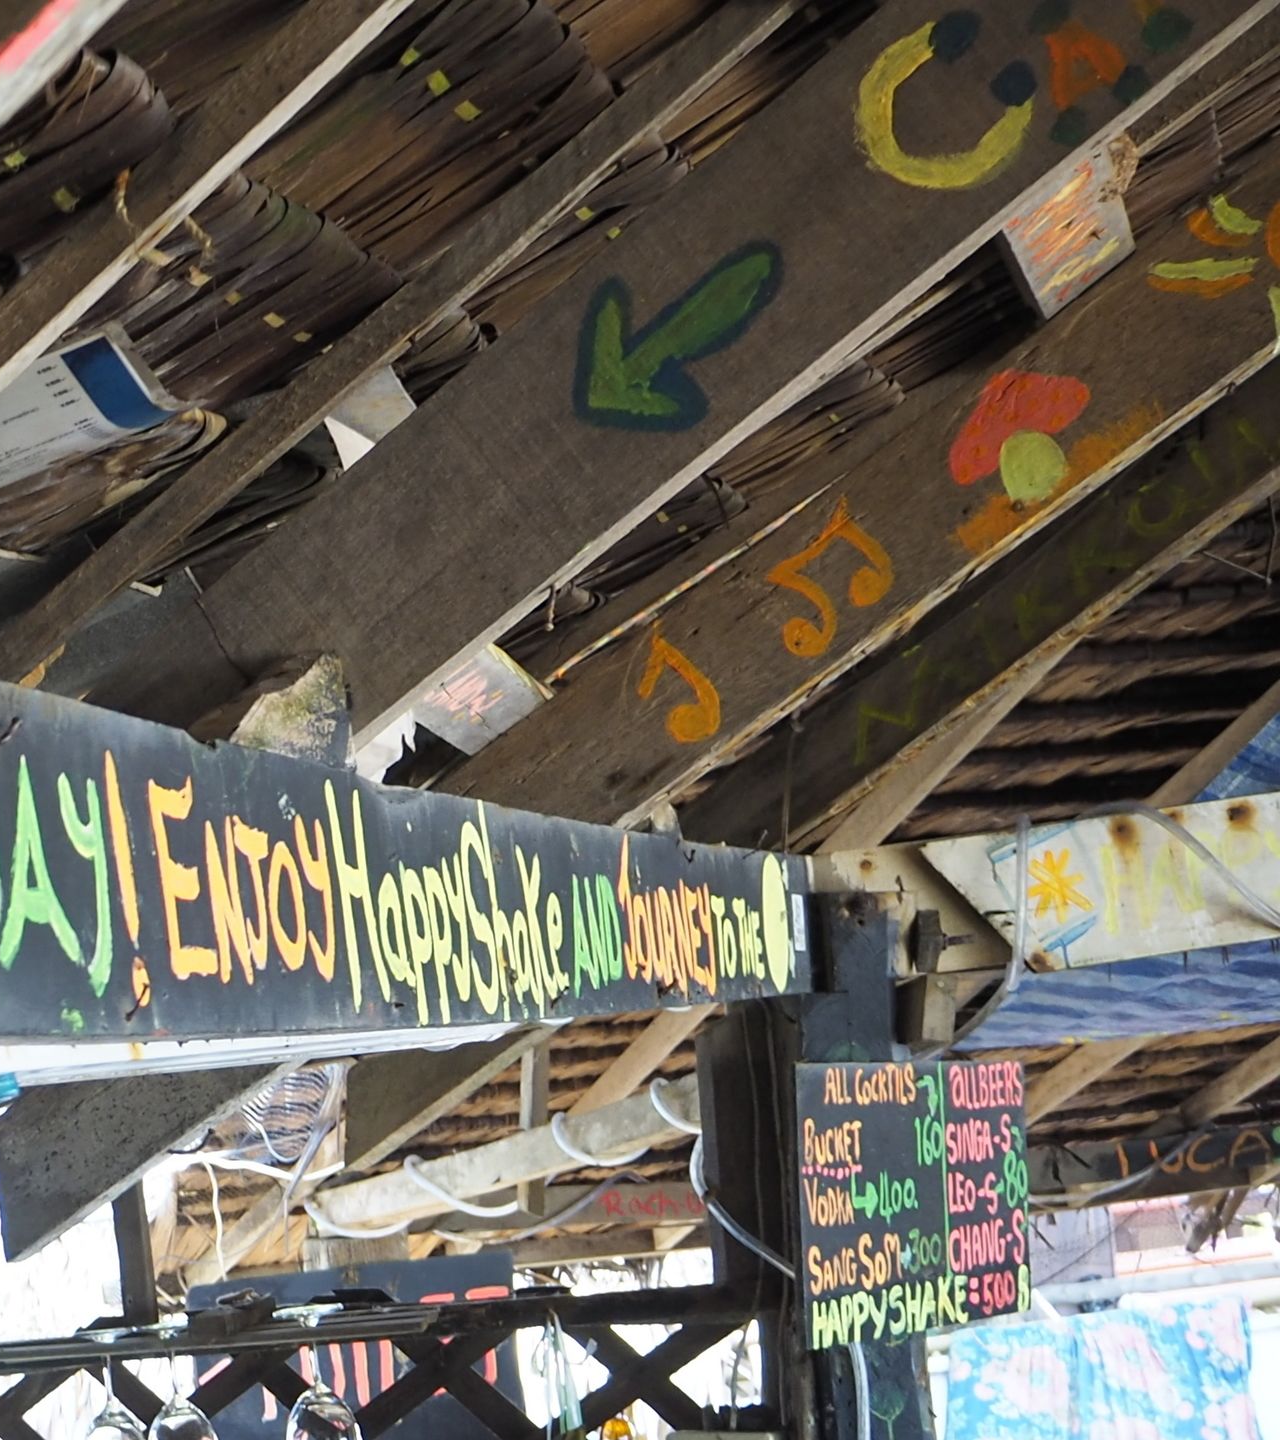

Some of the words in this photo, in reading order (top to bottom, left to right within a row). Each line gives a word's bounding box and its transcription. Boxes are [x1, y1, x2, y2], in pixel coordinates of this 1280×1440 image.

[147, 775, 335, 986] ENJOY
[572, 872, 624, 999] AND
[616, 831, 718, 997] JOURNEY
[731, 896, 766, 981] THE
[824, 1066, 852, 1105] ALL
[914, 1115, 942, 1166] 160
[1003, 1150, 1028, 1208] 80
[907, 1228, 941, 1275] 300
